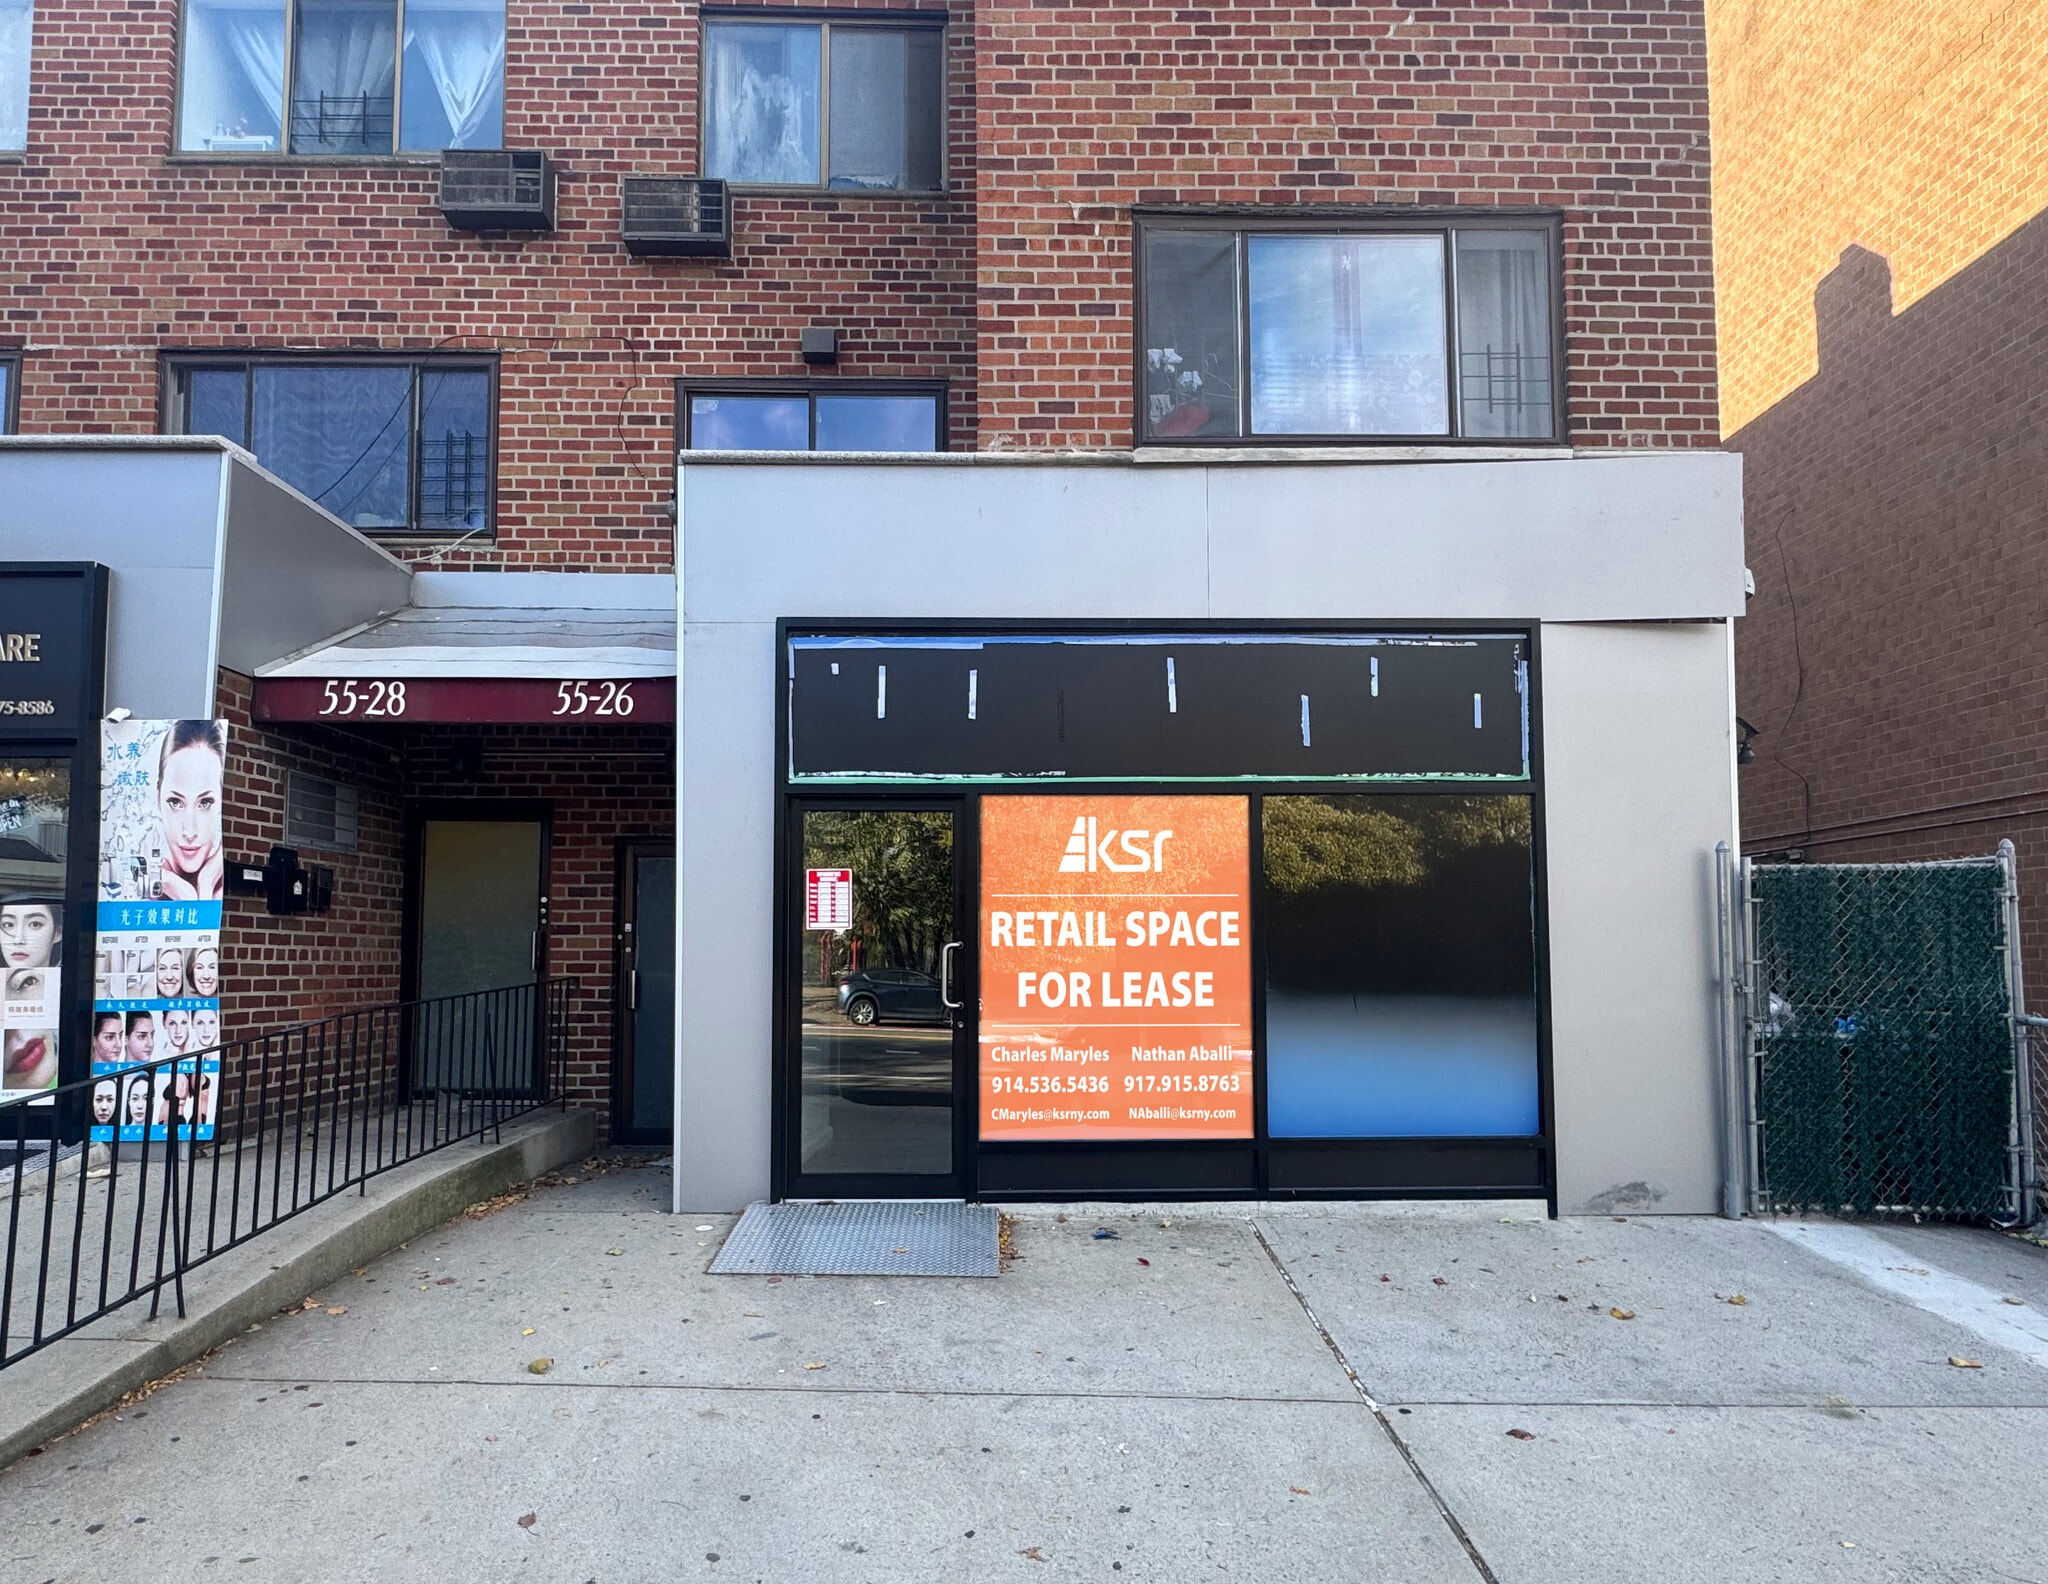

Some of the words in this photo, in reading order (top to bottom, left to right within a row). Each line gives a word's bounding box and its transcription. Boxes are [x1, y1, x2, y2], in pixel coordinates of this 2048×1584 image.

[319, 680, 406, 716] 55-28
[552, 680, 634, 716] 55-26
[1089, 817, 1172, 872] ksr
[121, 908, 198, 926] 光子效果对比
[992, 912, 1116, 946] RETAIL
[1126, 911, 1240, 947] SPACE
[1018, 972, 1092, 1007] FOR
[1102, 972, 1215, 1007] LEASE
[991, 1047, 1047, 1062] Charles
[1050, 1047, 1110, 1065] Maryles
[1131, 1046, 1186, 1061] Nathan
[1189, 1046, 1233, 1061] Aballi
[991, 1076, 1109, 1093] 914.536.5436
[1124, 1075, 1240, 1092] 917.915.8763
[991, 1108, 1110, 1122] CMaryles@ksrny.com
[1129, 1107, 1237, 1121] NAballi@ksrny.com
